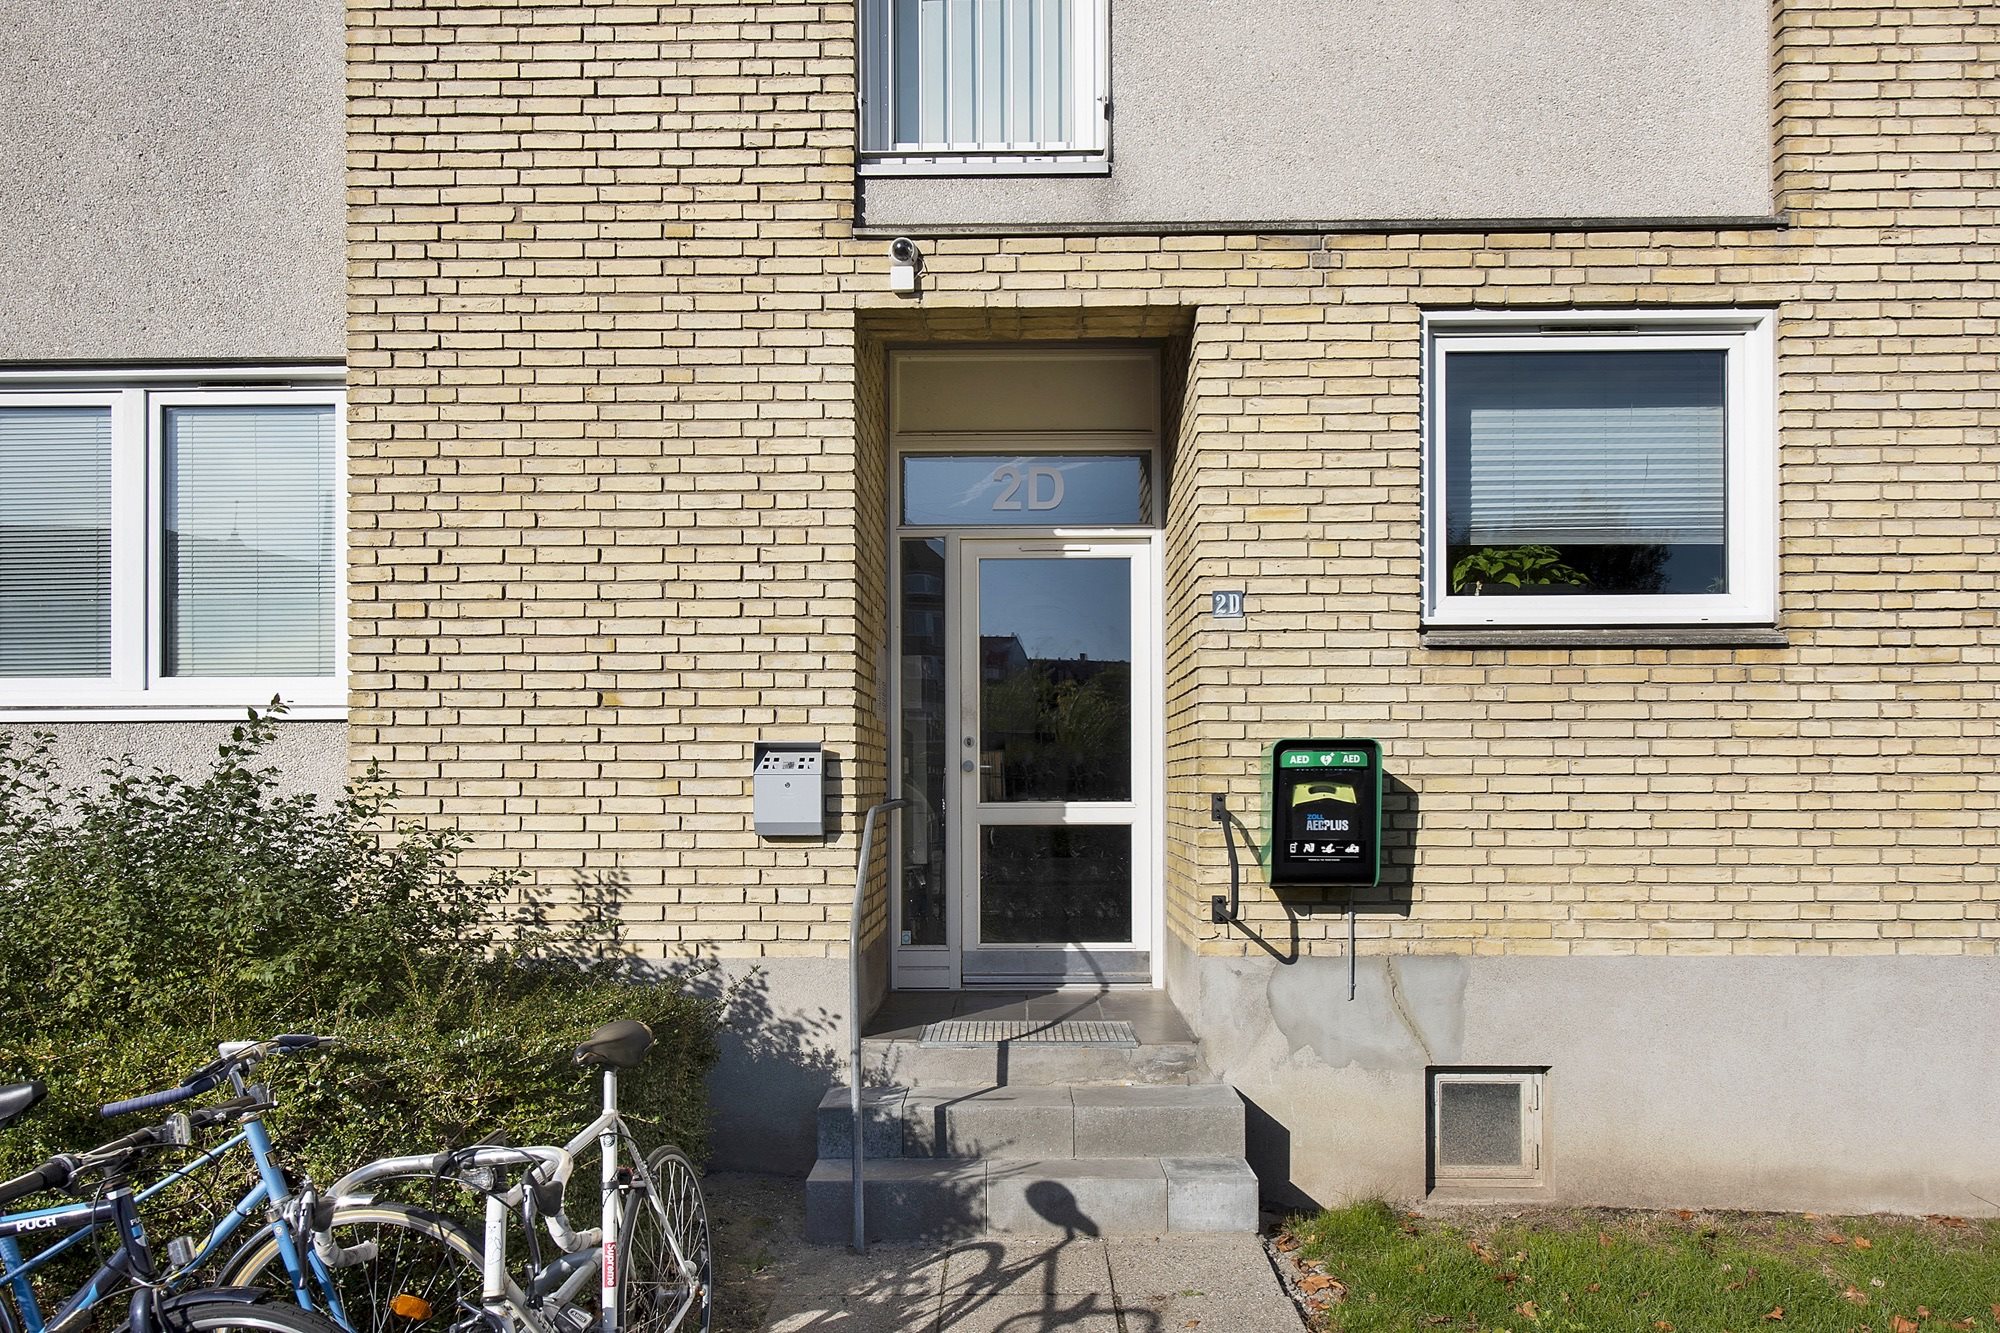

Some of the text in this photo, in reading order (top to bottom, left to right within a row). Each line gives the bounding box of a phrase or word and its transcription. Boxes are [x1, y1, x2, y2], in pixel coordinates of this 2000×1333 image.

[992, 466, 1064, 511] 2D
[1215, 594, 1240, 614] 2D
[1289, 755, 1310, 764] AED
[1342, 755, 1360, 763] AED
[16, 1217, 57, 1232] PUCH
[606, 1243, 616, 1287] Supreme
